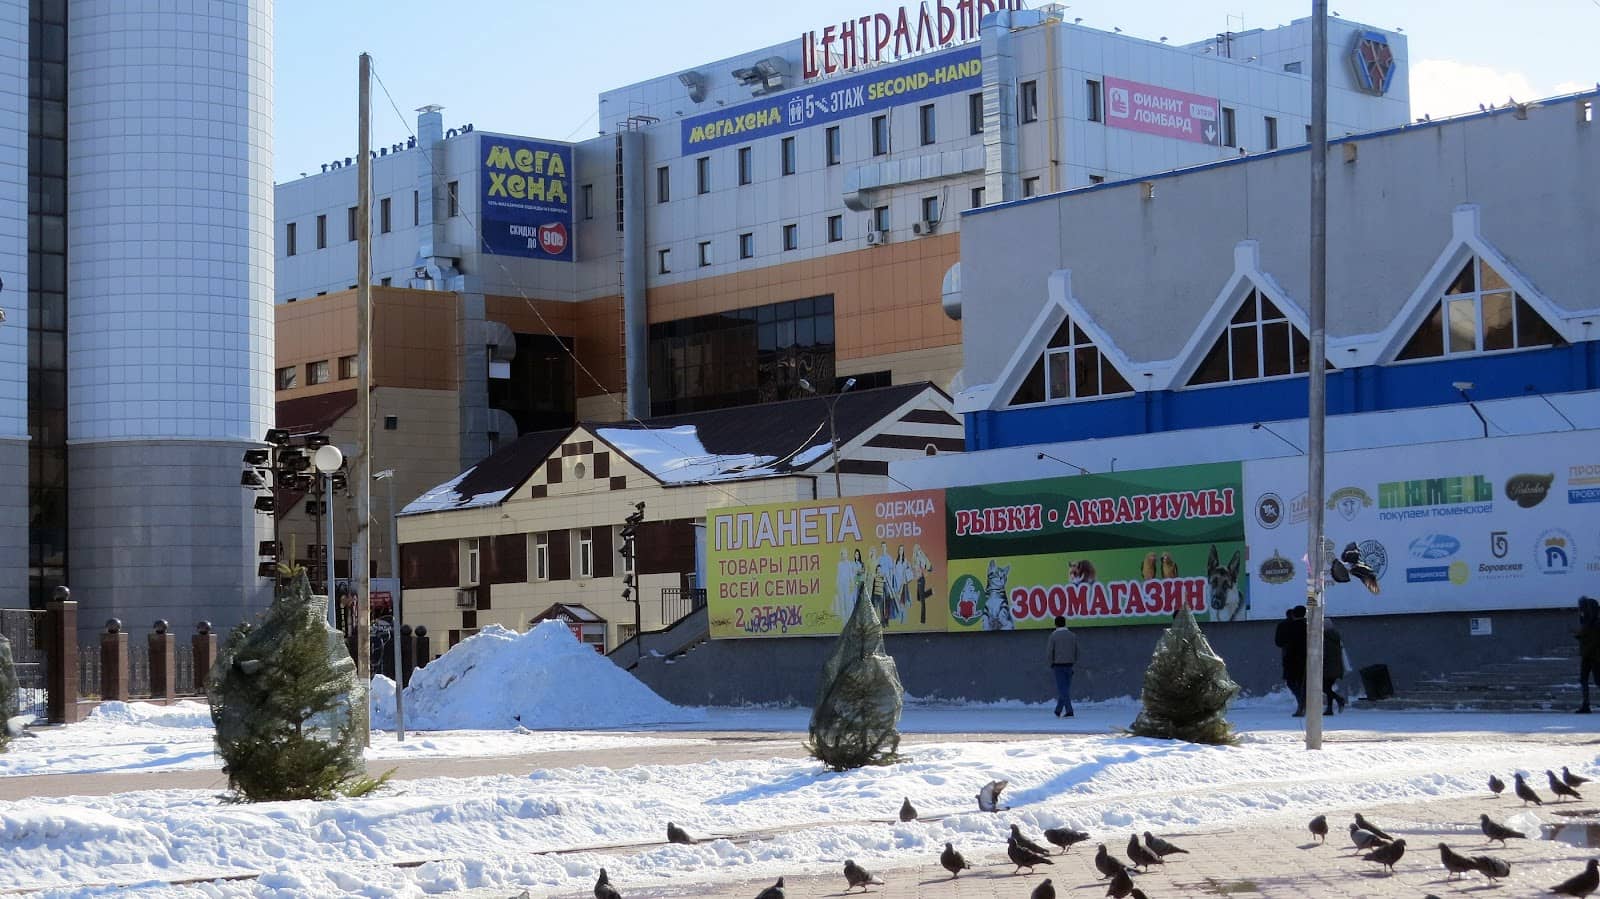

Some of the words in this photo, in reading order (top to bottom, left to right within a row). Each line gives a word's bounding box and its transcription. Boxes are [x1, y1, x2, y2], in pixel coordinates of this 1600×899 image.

[805, 94, 815, 119] 5
[830, 84, 865, 113] ЭТАЖ
[867, 58, 982, 100] SECOND-HAND
[1133, 92, 1183, 113] ФИАНИТ
[1134, 109, 1193, 134] ЛОМБАРД
[509, 224, 537, 238] СКИДКИ
[1377, 474, 1493, 509] ТЮМЕНЬ
[875, 498, 936, 519] ОДЕЖДА
[955, 503, 1043, 536] РЫБКИ
[1062, 488, 1235, 528] АКВАРИУМЫ
[714, 503, 863, 552] ПЛАНЕТА
[875, 520, 922, 539] ОБУВЬ
[719, 557, 783, 577] ТОВАРЫ
[787, 554, 820, 575] ДЛЯ
[719, 577, 760, 599] ВСЕЙ
[764, 578, 820, 597] СЕМЬИ
[1011, 577, 1209, 621] ЗООМАГАЗИН
[735, 607, 745, 628] 2
[750, 604, 803, 626] ЭТАЖ
